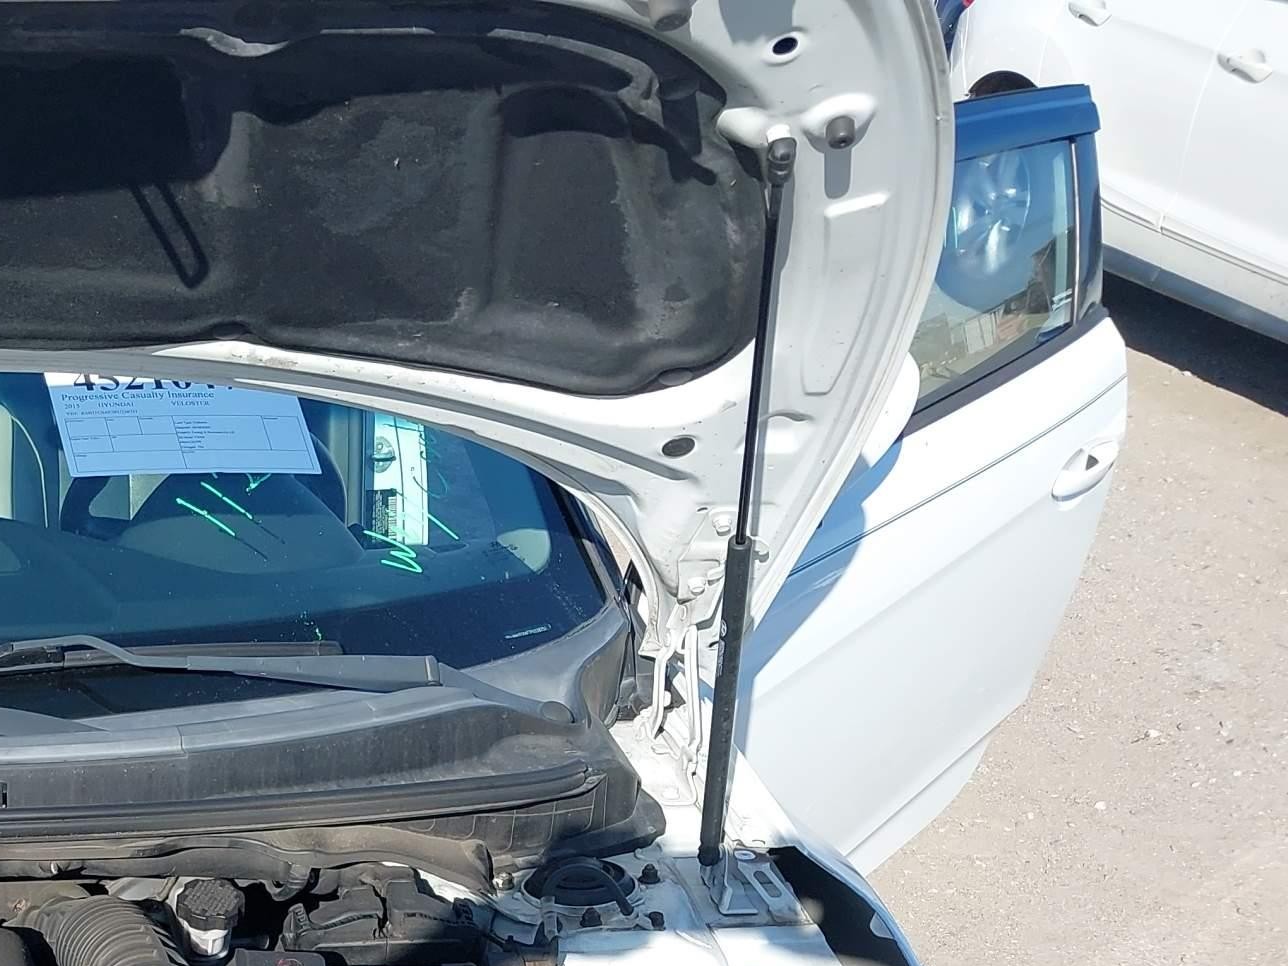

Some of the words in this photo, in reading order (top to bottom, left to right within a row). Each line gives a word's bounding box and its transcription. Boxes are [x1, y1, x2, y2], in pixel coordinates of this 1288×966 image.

[61, 392, 119, 403] Progressive
[121, 391, 165, 401] Casualty
[167, 390, 215, 400] Insurance
